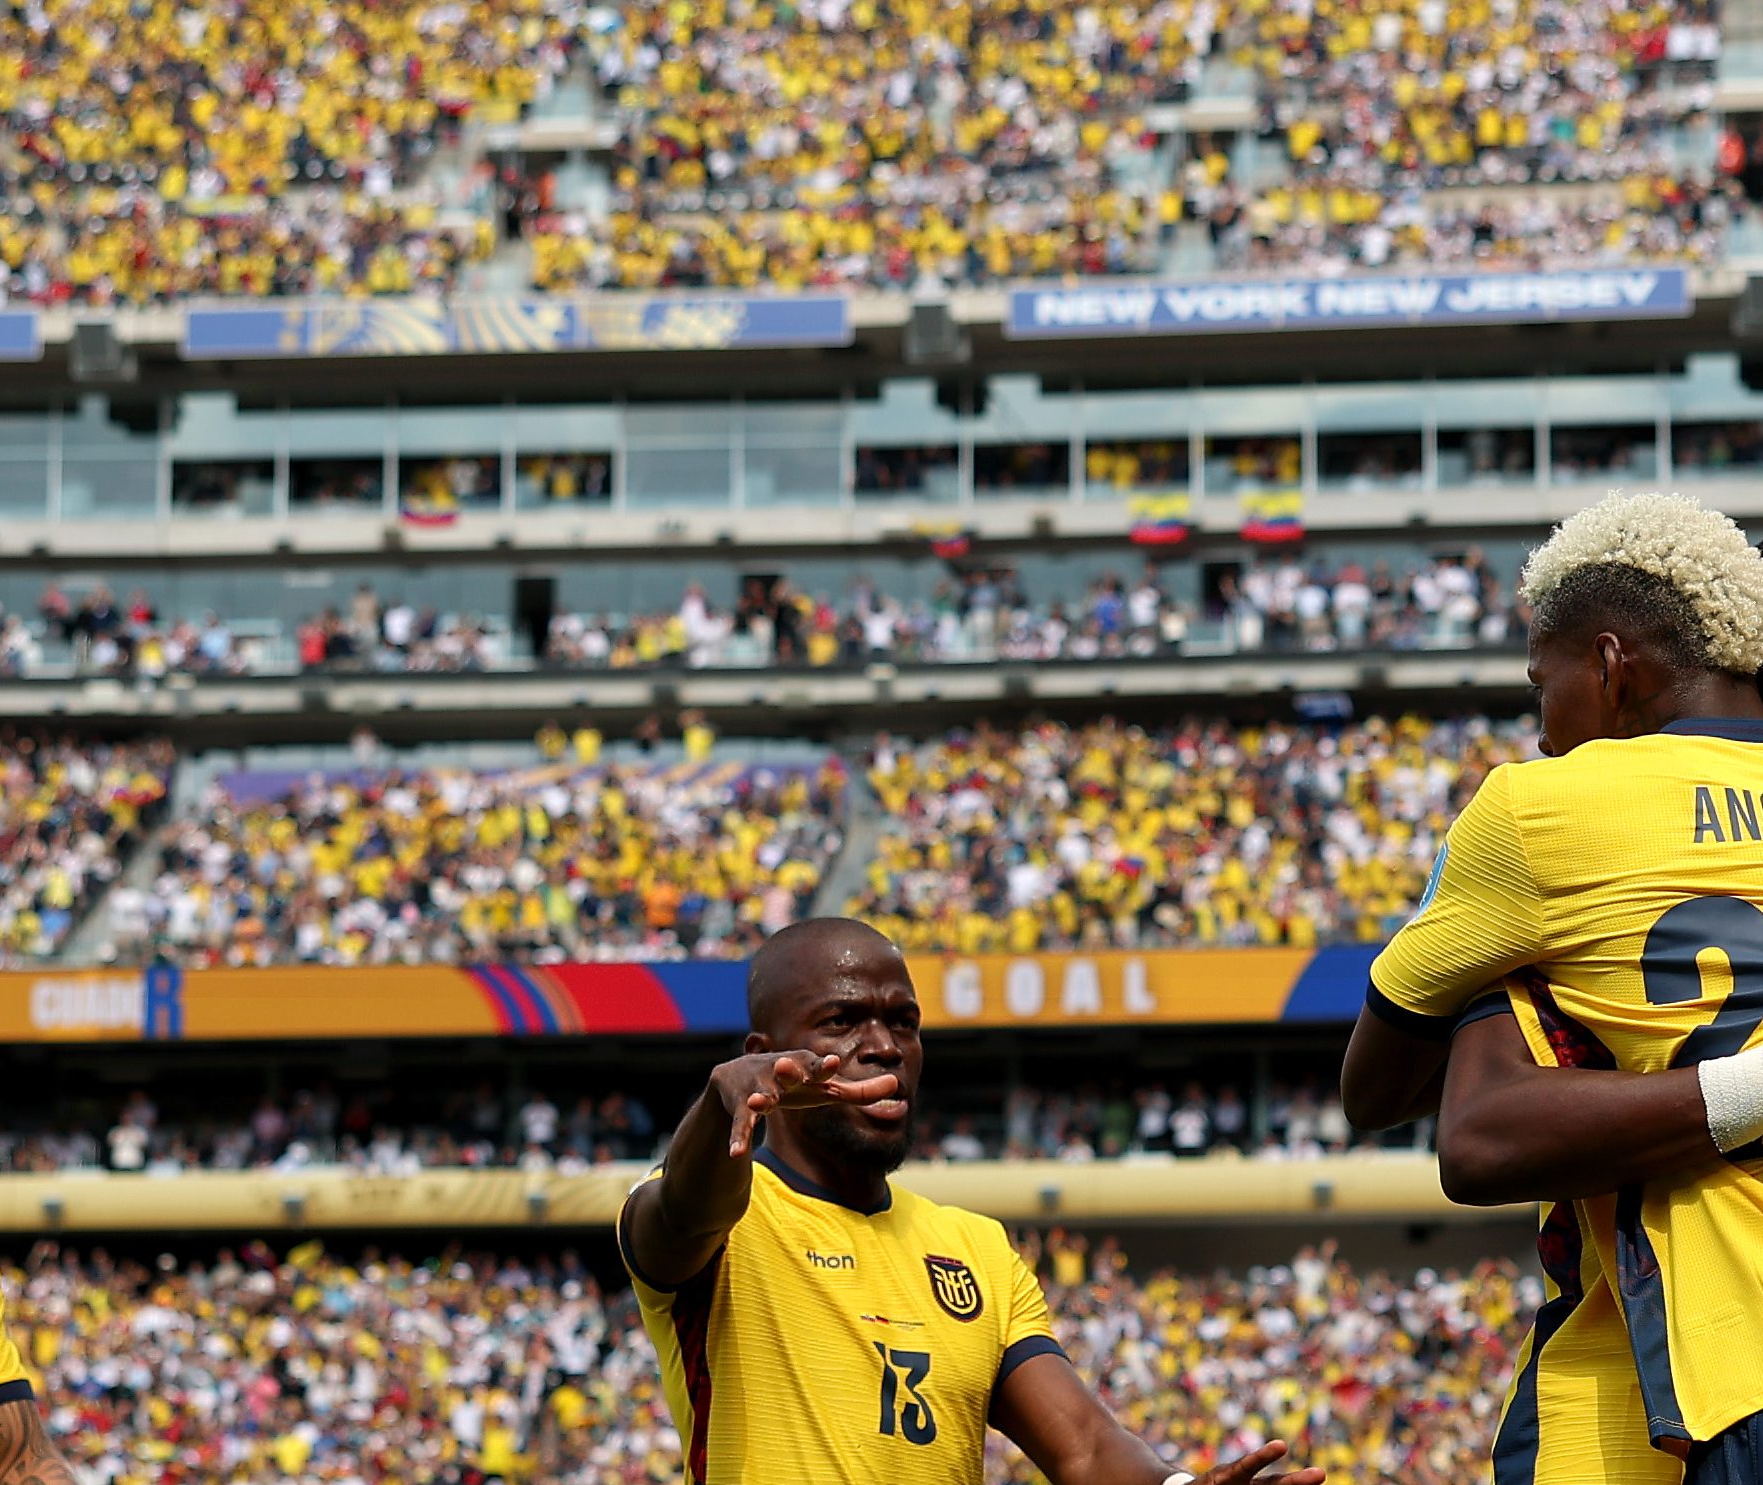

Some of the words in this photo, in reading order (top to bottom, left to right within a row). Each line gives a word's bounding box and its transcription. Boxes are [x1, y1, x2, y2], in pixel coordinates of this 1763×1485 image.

[1034, 290, 1156, 326] NEW
[1164, 284, 1312, 321] YORK
[1315, 279, 1442, 317] NEW
[1447, 270, 1659, 313] JERSEY
[944, 956, 1157, 1019] GOAL
[873, 1340, 937, 1446] 13
